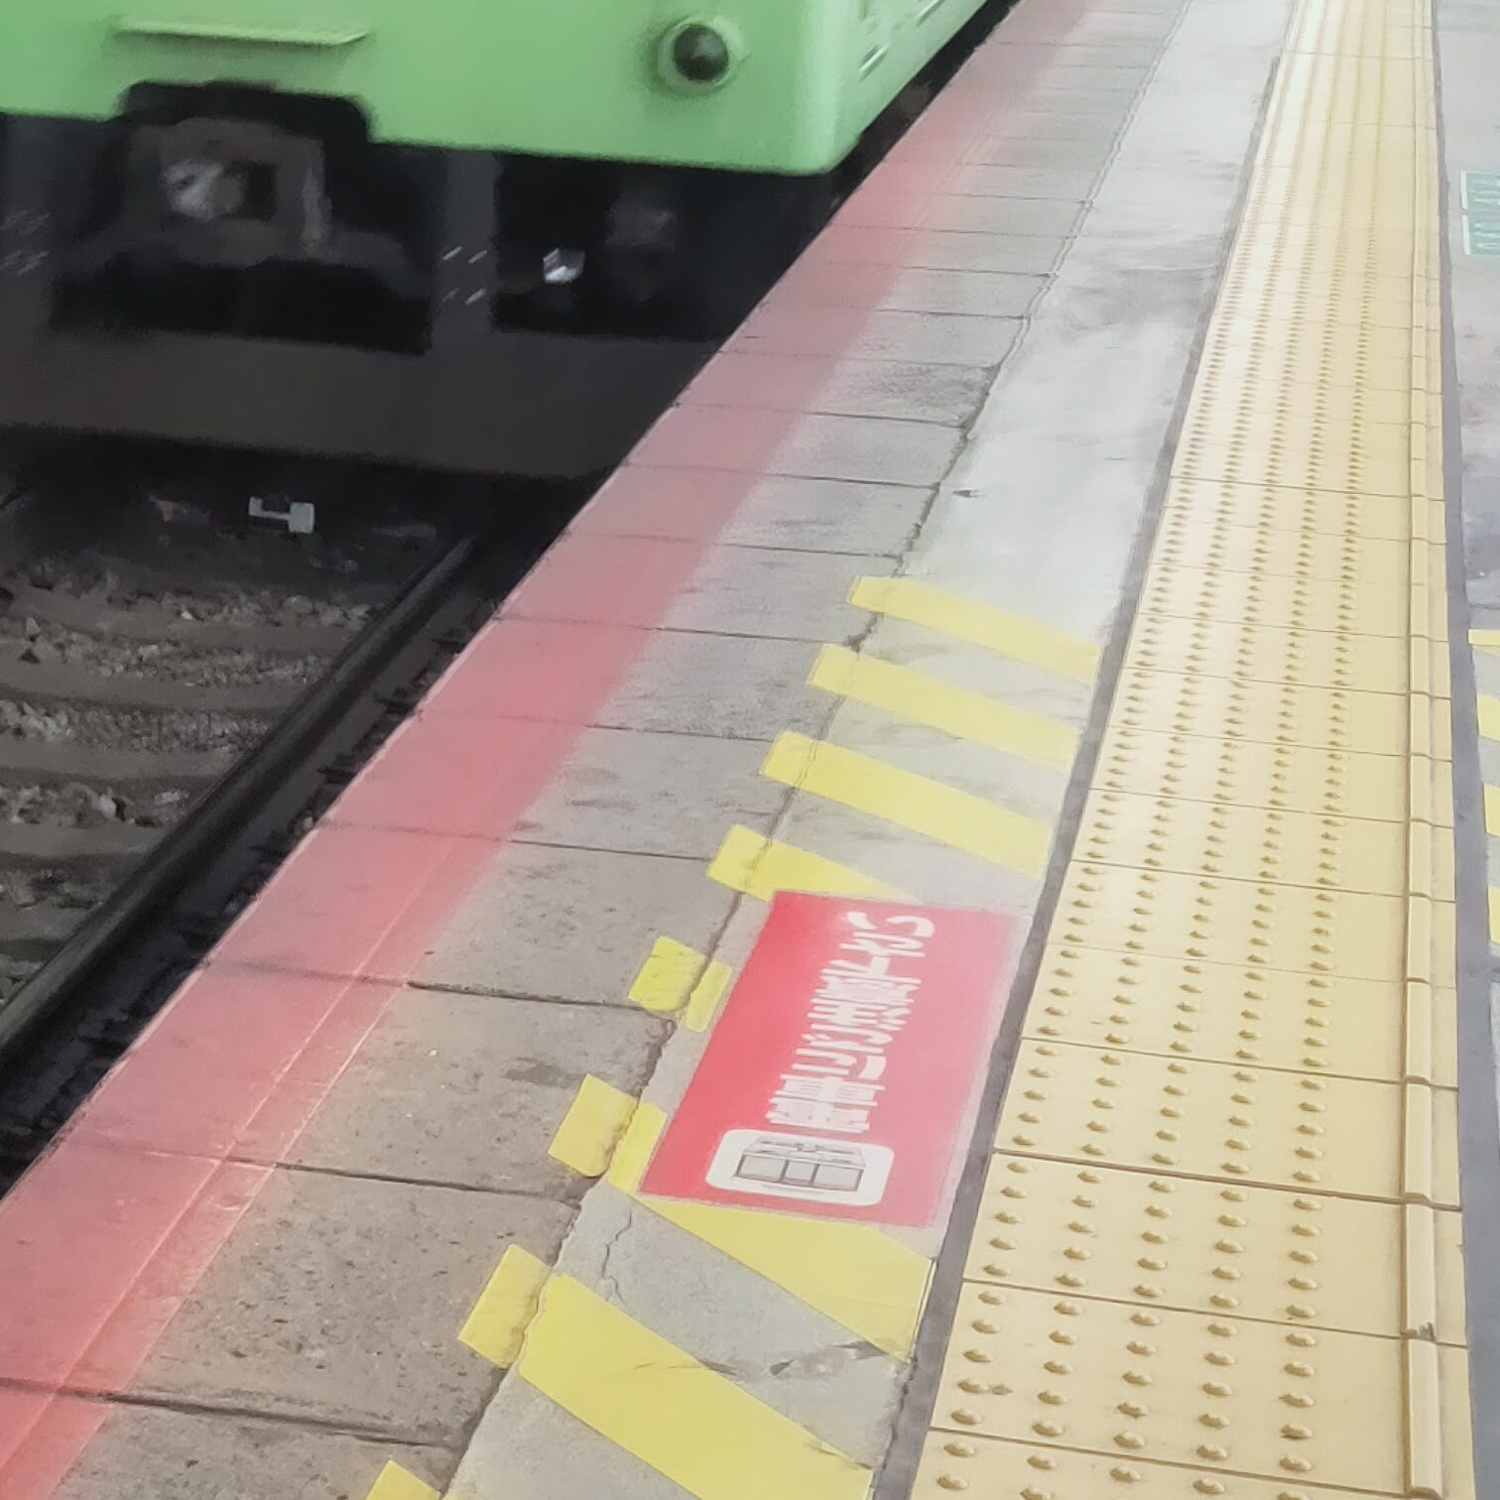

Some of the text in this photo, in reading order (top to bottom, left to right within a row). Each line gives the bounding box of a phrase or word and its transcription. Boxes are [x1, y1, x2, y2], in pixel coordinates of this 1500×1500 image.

[765, 911, 936, 1134] 電車にご注意下さい
